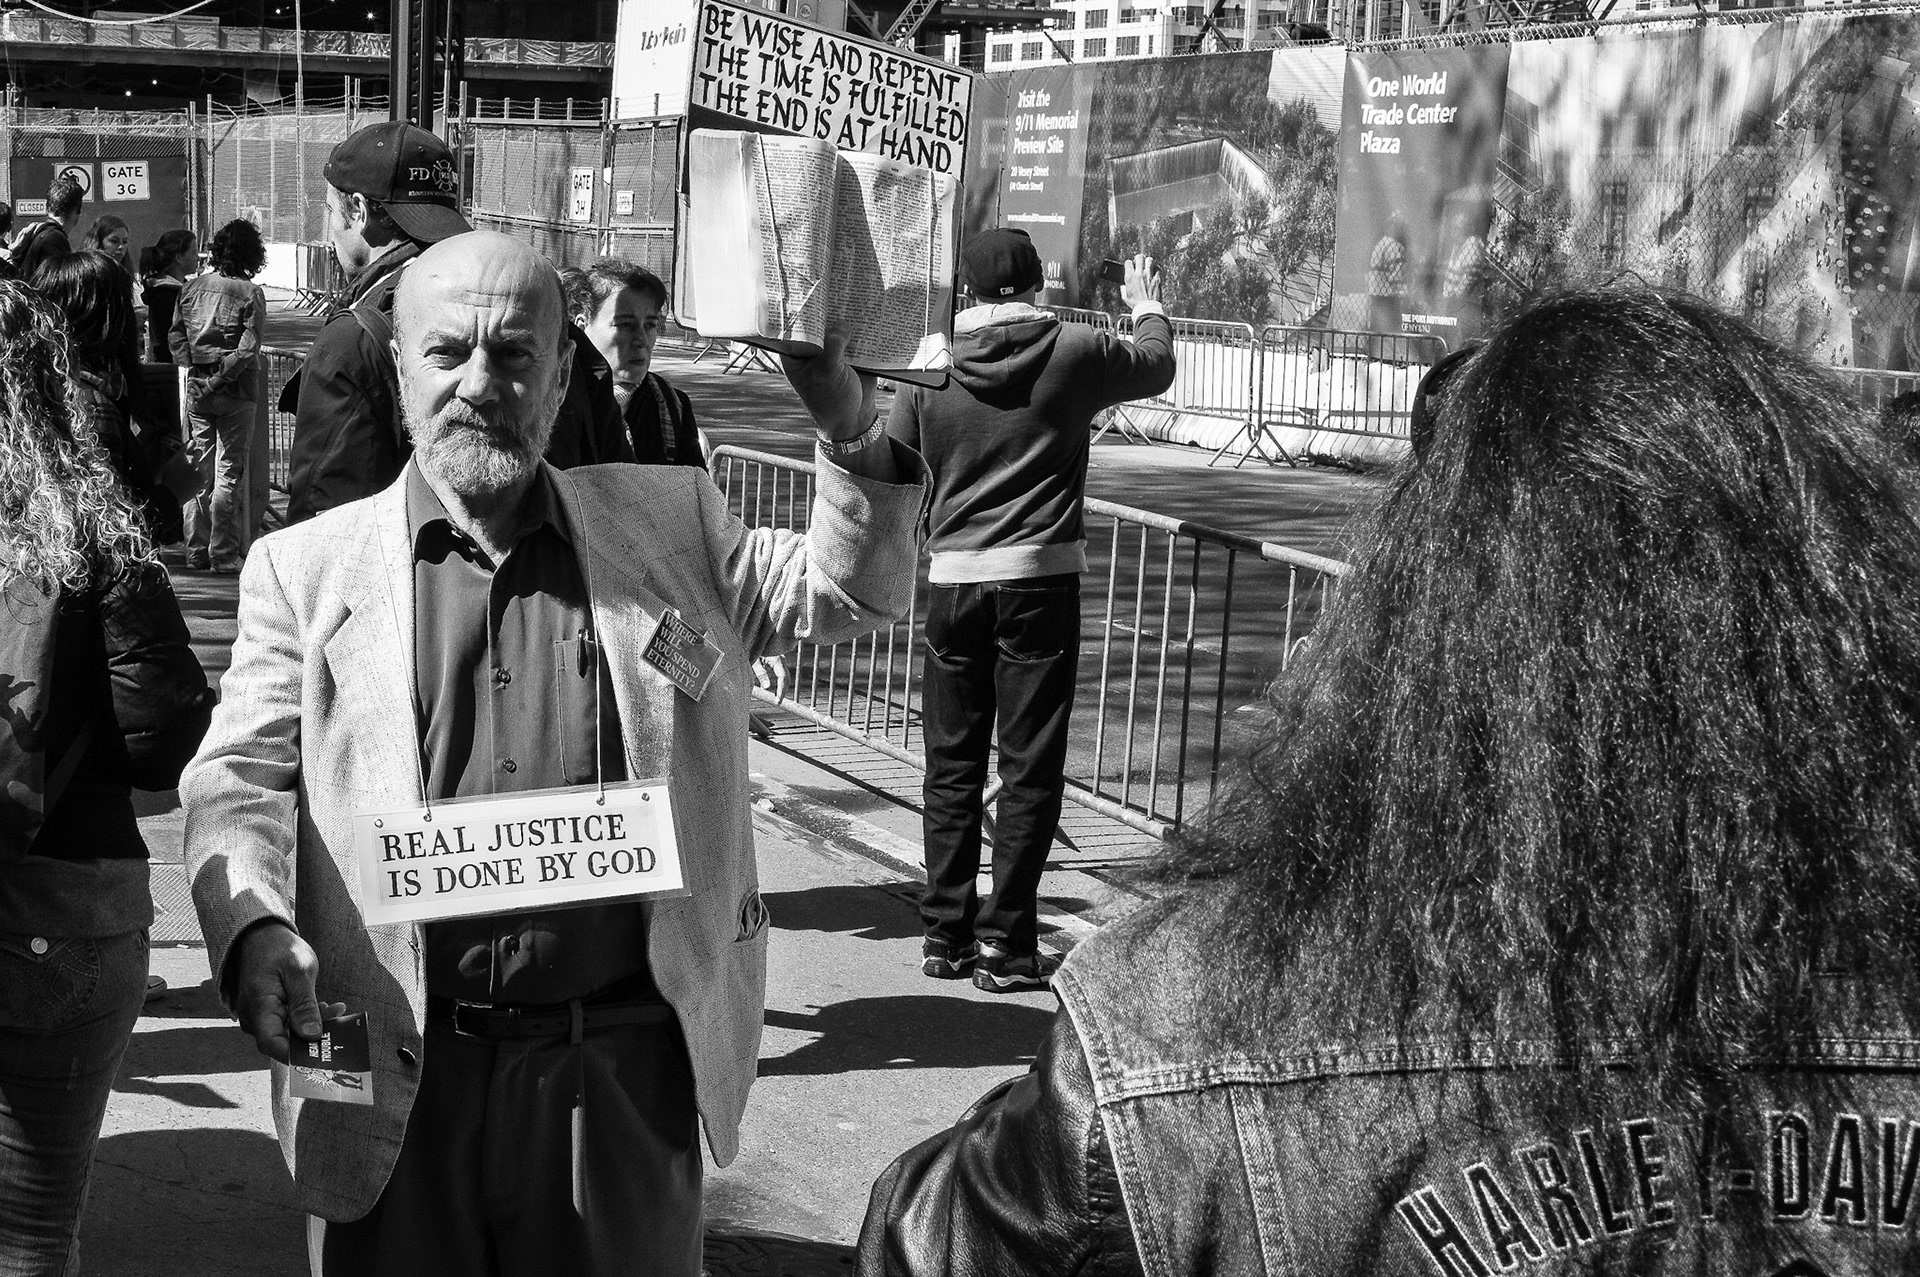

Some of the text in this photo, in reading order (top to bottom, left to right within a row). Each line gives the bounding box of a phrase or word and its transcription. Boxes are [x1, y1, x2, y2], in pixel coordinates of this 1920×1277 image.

[703, 3, 736, 41] BE
[742, 13, 806, 60] WISE
[809, 36, 863, 76] AND
[869, 51, 961, 107] REPENT.
[702, 37, 750, 80] THE
[758, 51, 815, 98] TIME
[821, 67, 842, 105] IS
[848, 78, 965, 146] FULFILLED.
[1366, 71, 1447, 97] One World
[1017, 88, 1051, 108] Visit the
[698, 72, 751, 118] THE
[756, 88, 809, 132] END
[813, 101, 833, 140] IS
[836, 112, 876, 151] AT
[1014, 110, 1079, 134] 9/11 Memorial
[1361, 102, 1458, 125] Trade Center
[1013, 135, 1065, 154] Preview Site
[1360, 130, 1401, 154] Plaza
[107, 166, 144, 179] GATE
[408, 167, 430, 181] FD
[574, 174, 591, 190] GATE
[117, 183, 137, 196] 3G
[19, 203, 45, 213] CLOSED
[660, 626, 682, 650] WILL
[665, 612, 698, 646] WHERE
[646, 648, 696, 690] ETERNITY?
[653, 636, 700, 678] YOU SPEND
[378, 813, 627, 863] REAL JUSTICE
[387, 846, 657, 899] IS DONE BY GOD
[320, 1032, 332, 1062] TROUBLE
